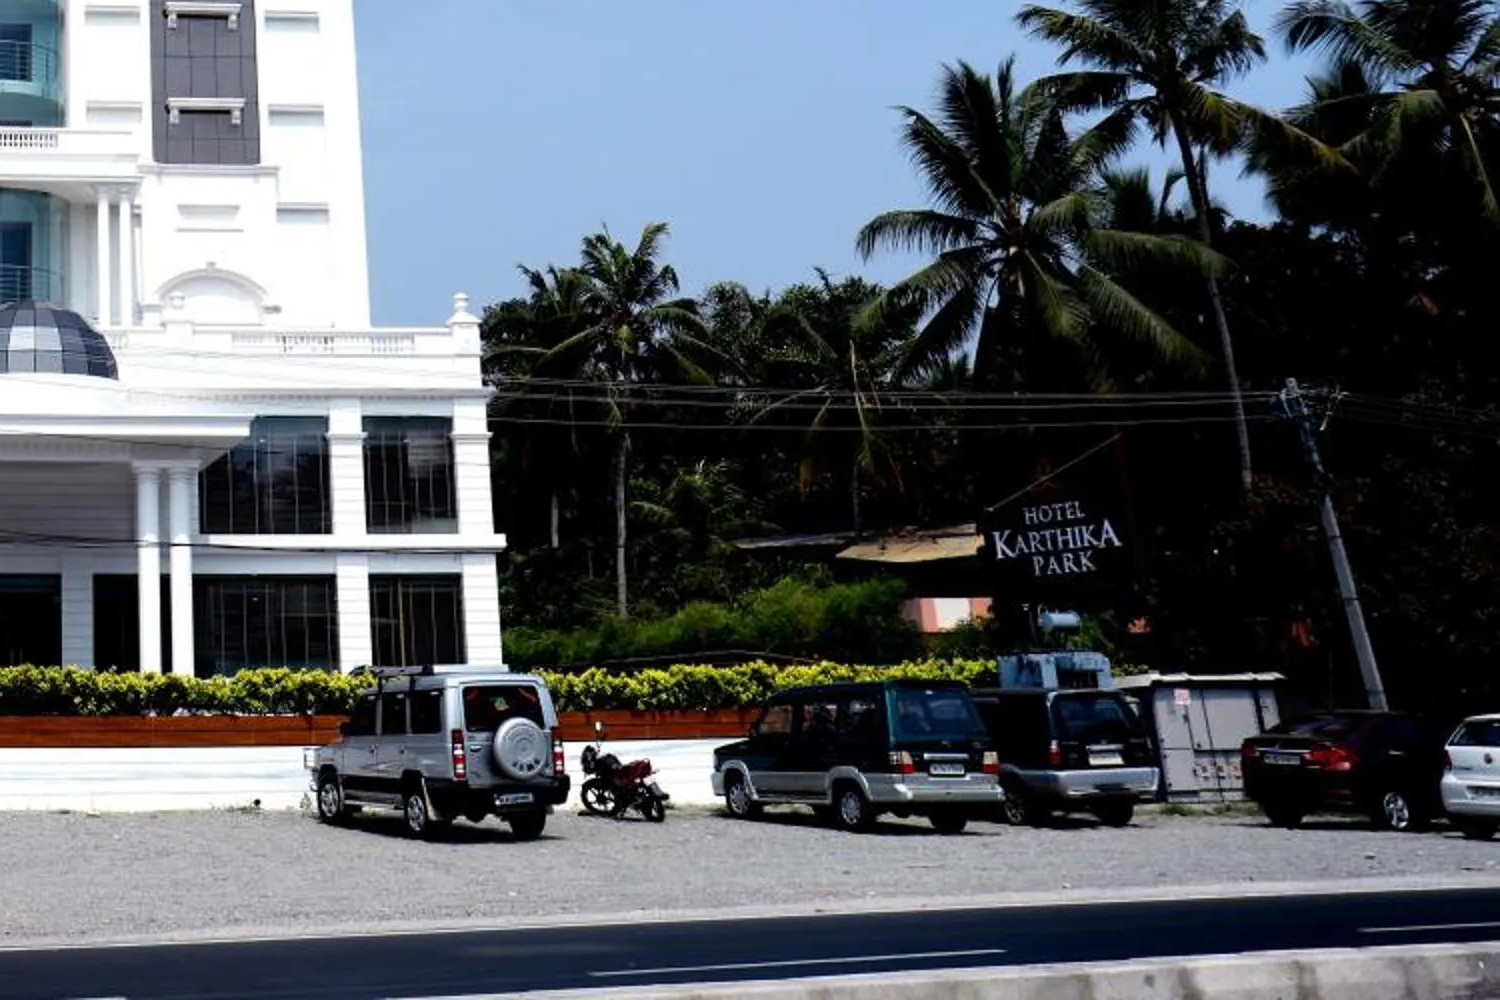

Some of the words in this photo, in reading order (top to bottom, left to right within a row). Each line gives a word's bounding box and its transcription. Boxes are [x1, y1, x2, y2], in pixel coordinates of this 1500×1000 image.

[1023, 501, 1086, 524] HOTEL
[992, 518, 1123, 559] KARTHIKA
[1032, 550, 1097, 576] PARK
